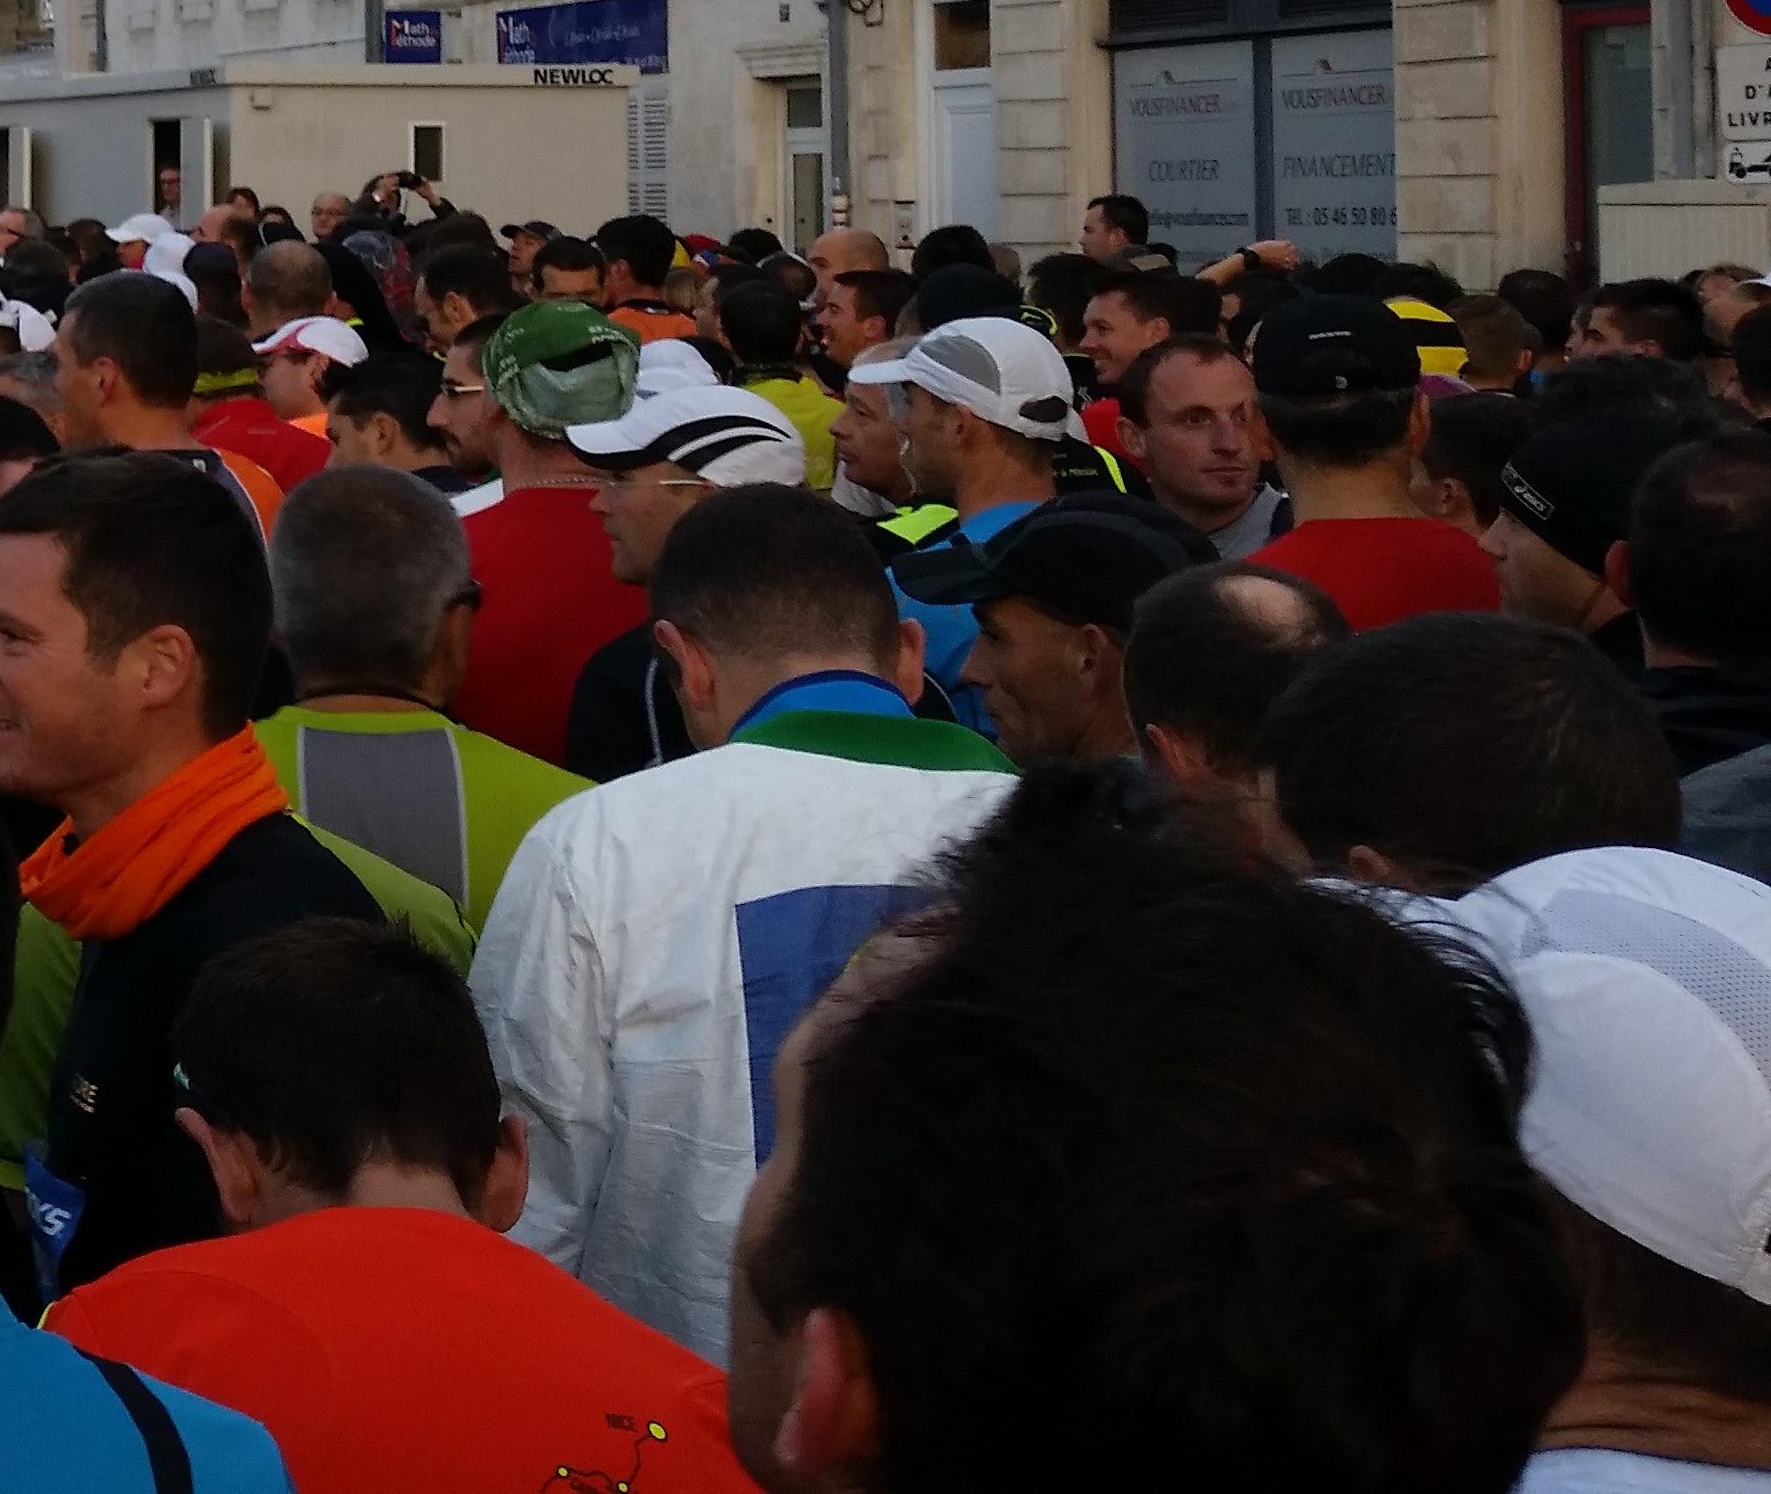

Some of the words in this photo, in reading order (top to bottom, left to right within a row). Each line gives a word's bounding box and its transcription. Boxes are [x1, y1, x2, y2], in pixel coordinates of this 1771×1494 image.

[533, 68, 614, 85] NEWLOC
[1148, 159, 1220, 182] COURTIER
[1314, 207, 1328, 226] 05
[1331, 207, 1348, 225] 46
[1351, 207, 1367, 225] 50
